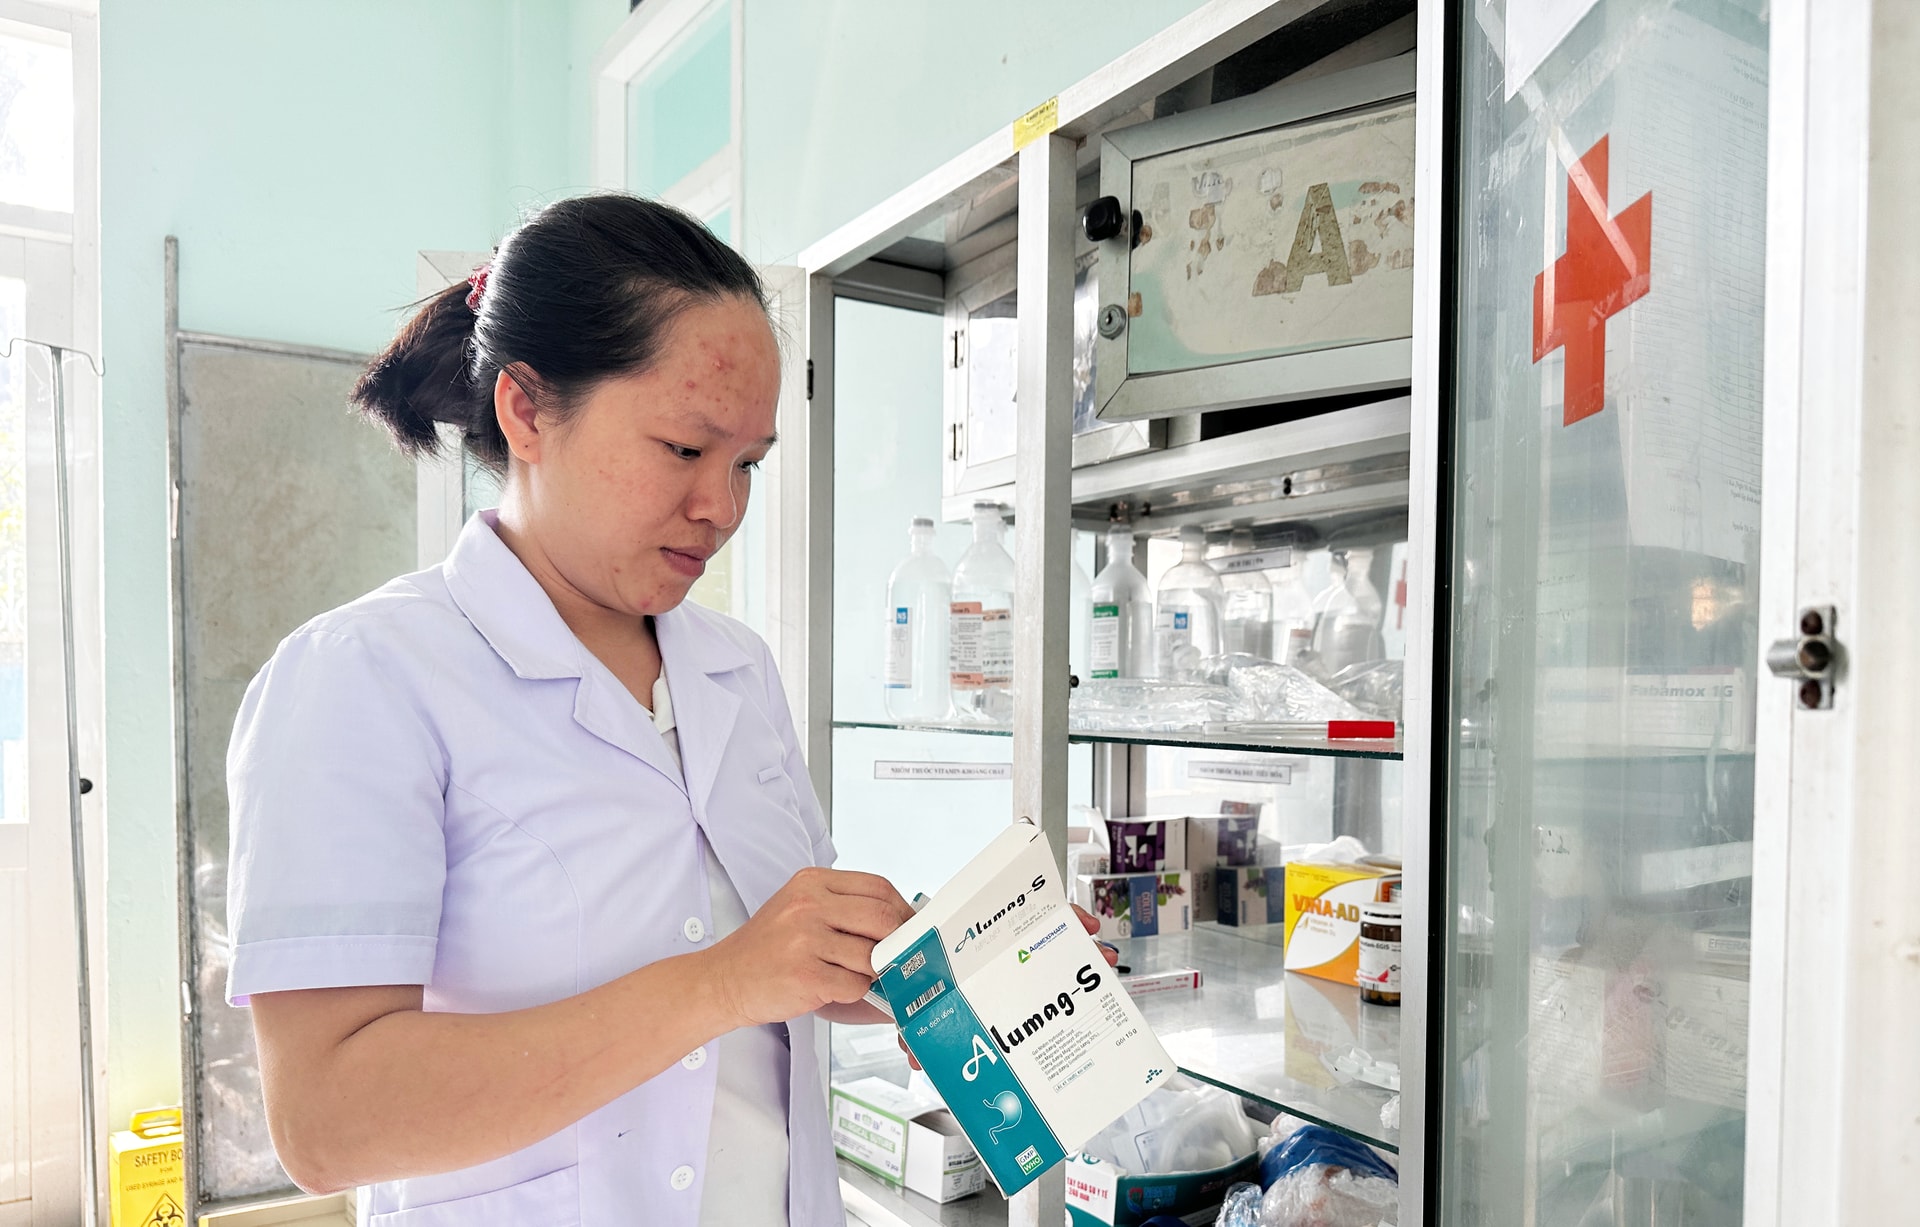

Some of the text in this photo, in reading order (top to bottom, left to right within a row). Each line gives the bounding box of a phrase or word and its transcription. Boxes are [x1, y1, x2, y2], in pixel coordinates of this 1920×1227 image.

[1286, 182, 1352, 293] A
[1629, 684, 1706, 697] Fabamox
[955, 874, 1046, 953] Alumag-S
[1293, 893, 1360, 922] VINA-AD
[962, 964, 1101, 1081] Alumag-S
[1115, 1037, 1126, 1047] Gói
[1125, 1031, 1133, 1039] 15
[135, 1148, 184, 1167] SAFETY BO
[1020, 1150, 1034, 1163] GMP
[1023, 1158, 1041, 1172] WHO
